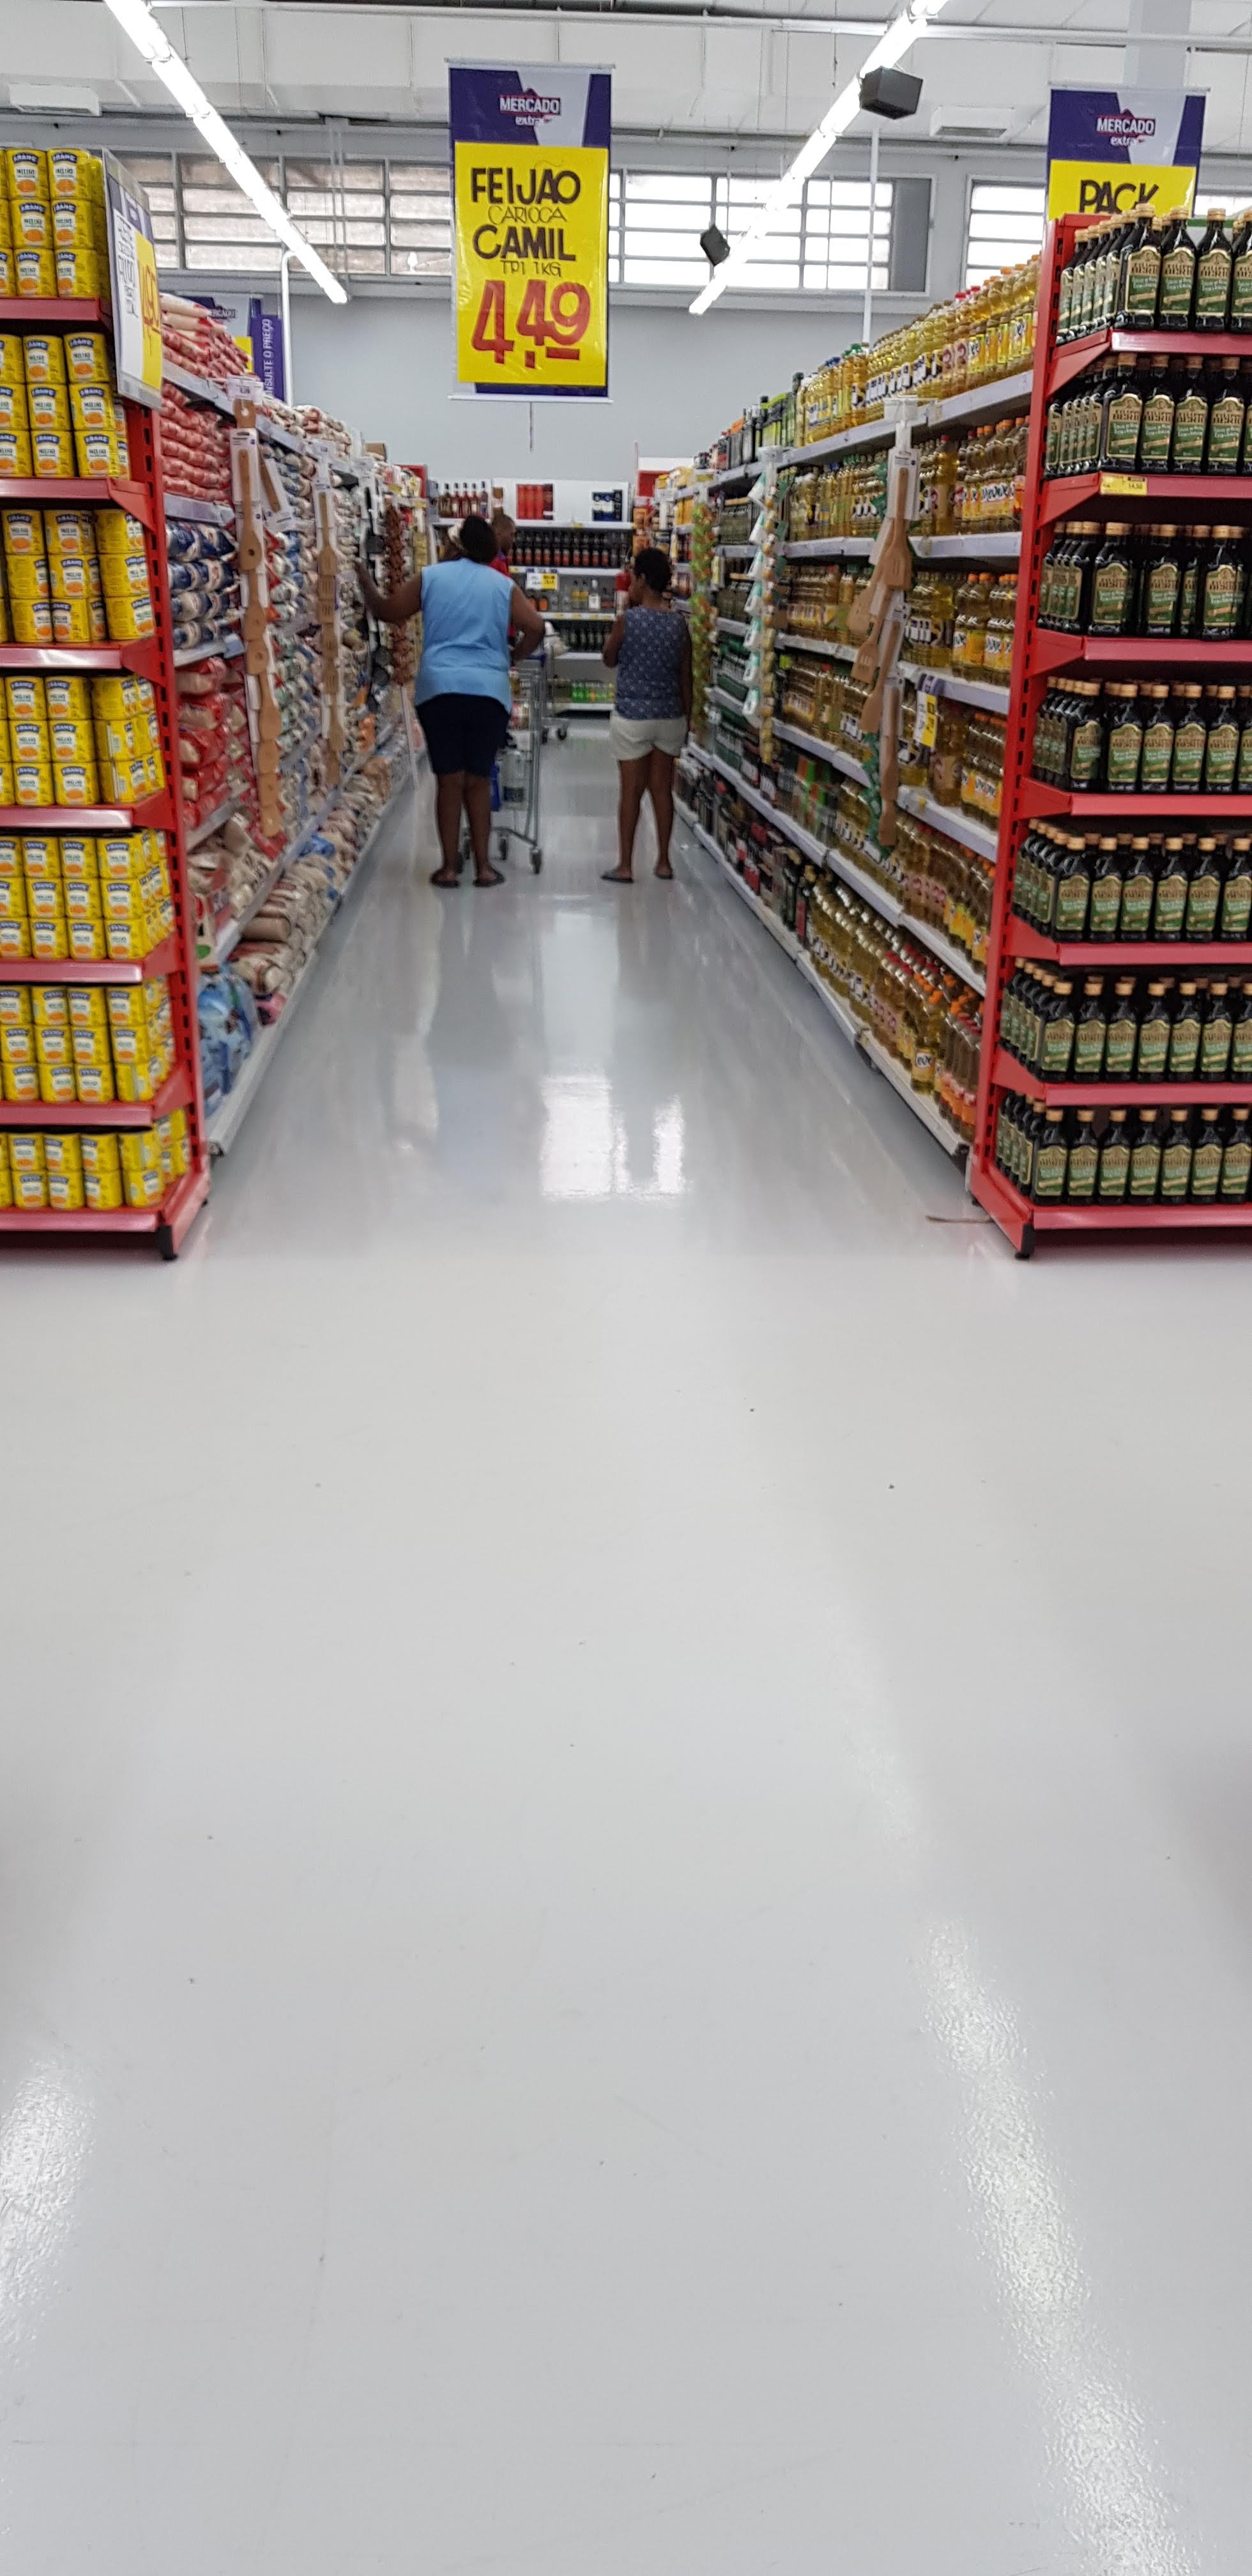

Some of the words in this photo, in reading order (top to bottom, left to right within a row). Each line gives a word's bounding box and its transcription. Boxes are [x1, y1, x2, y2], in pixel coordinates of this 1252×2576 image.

[500, 96, 560, 114] MERCADO
[1096, 118, 1154, 135] MERCADO
[1080, 180, 1159, 214] PACK
[488, 205, 567, 225] CARIOCA
[472, 224, 576, 261] CAMIL
[262, 318, 275, 349] PREÇO
[263, 350, 274, 358] O
